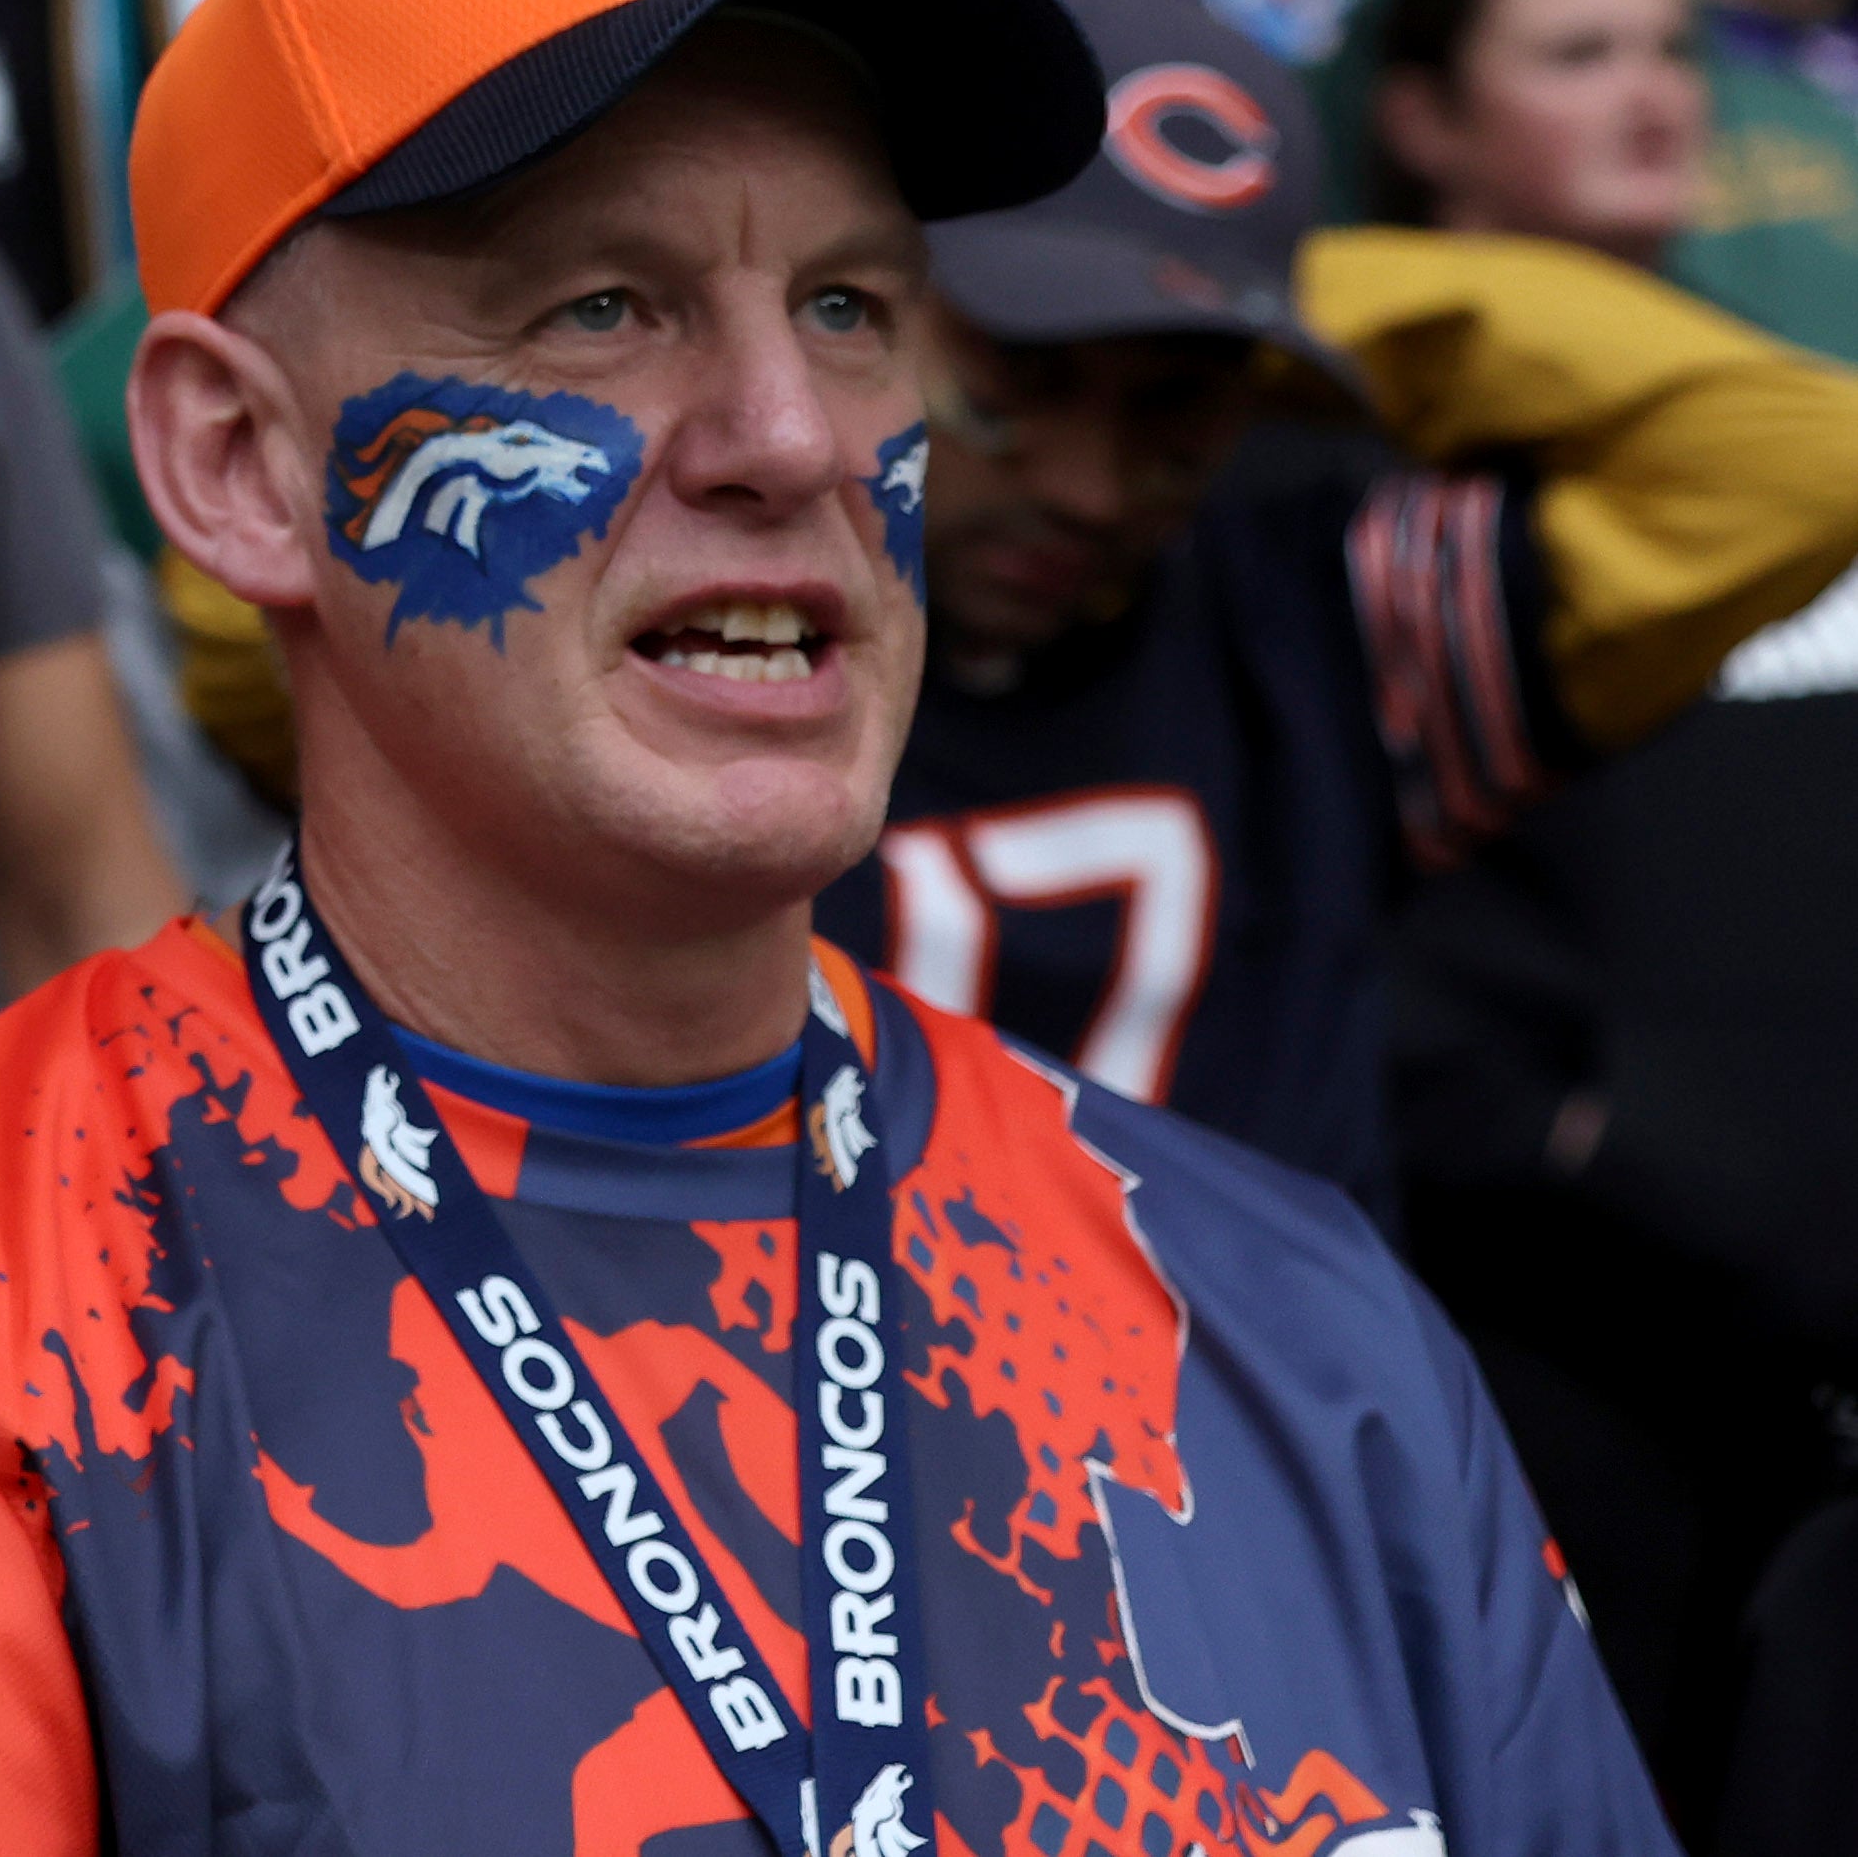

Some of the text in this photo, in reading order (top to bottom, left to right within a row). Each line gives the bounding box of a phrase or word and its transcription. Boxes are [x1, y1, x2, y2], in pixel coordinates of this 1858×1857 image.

[1103, 60, 1282, 213] C
[882, 783, 1221, 1104] 17
[456, 1274, 789, 1753] BRONCOS
[816, 1251, 904, 1729] BRONCOS
